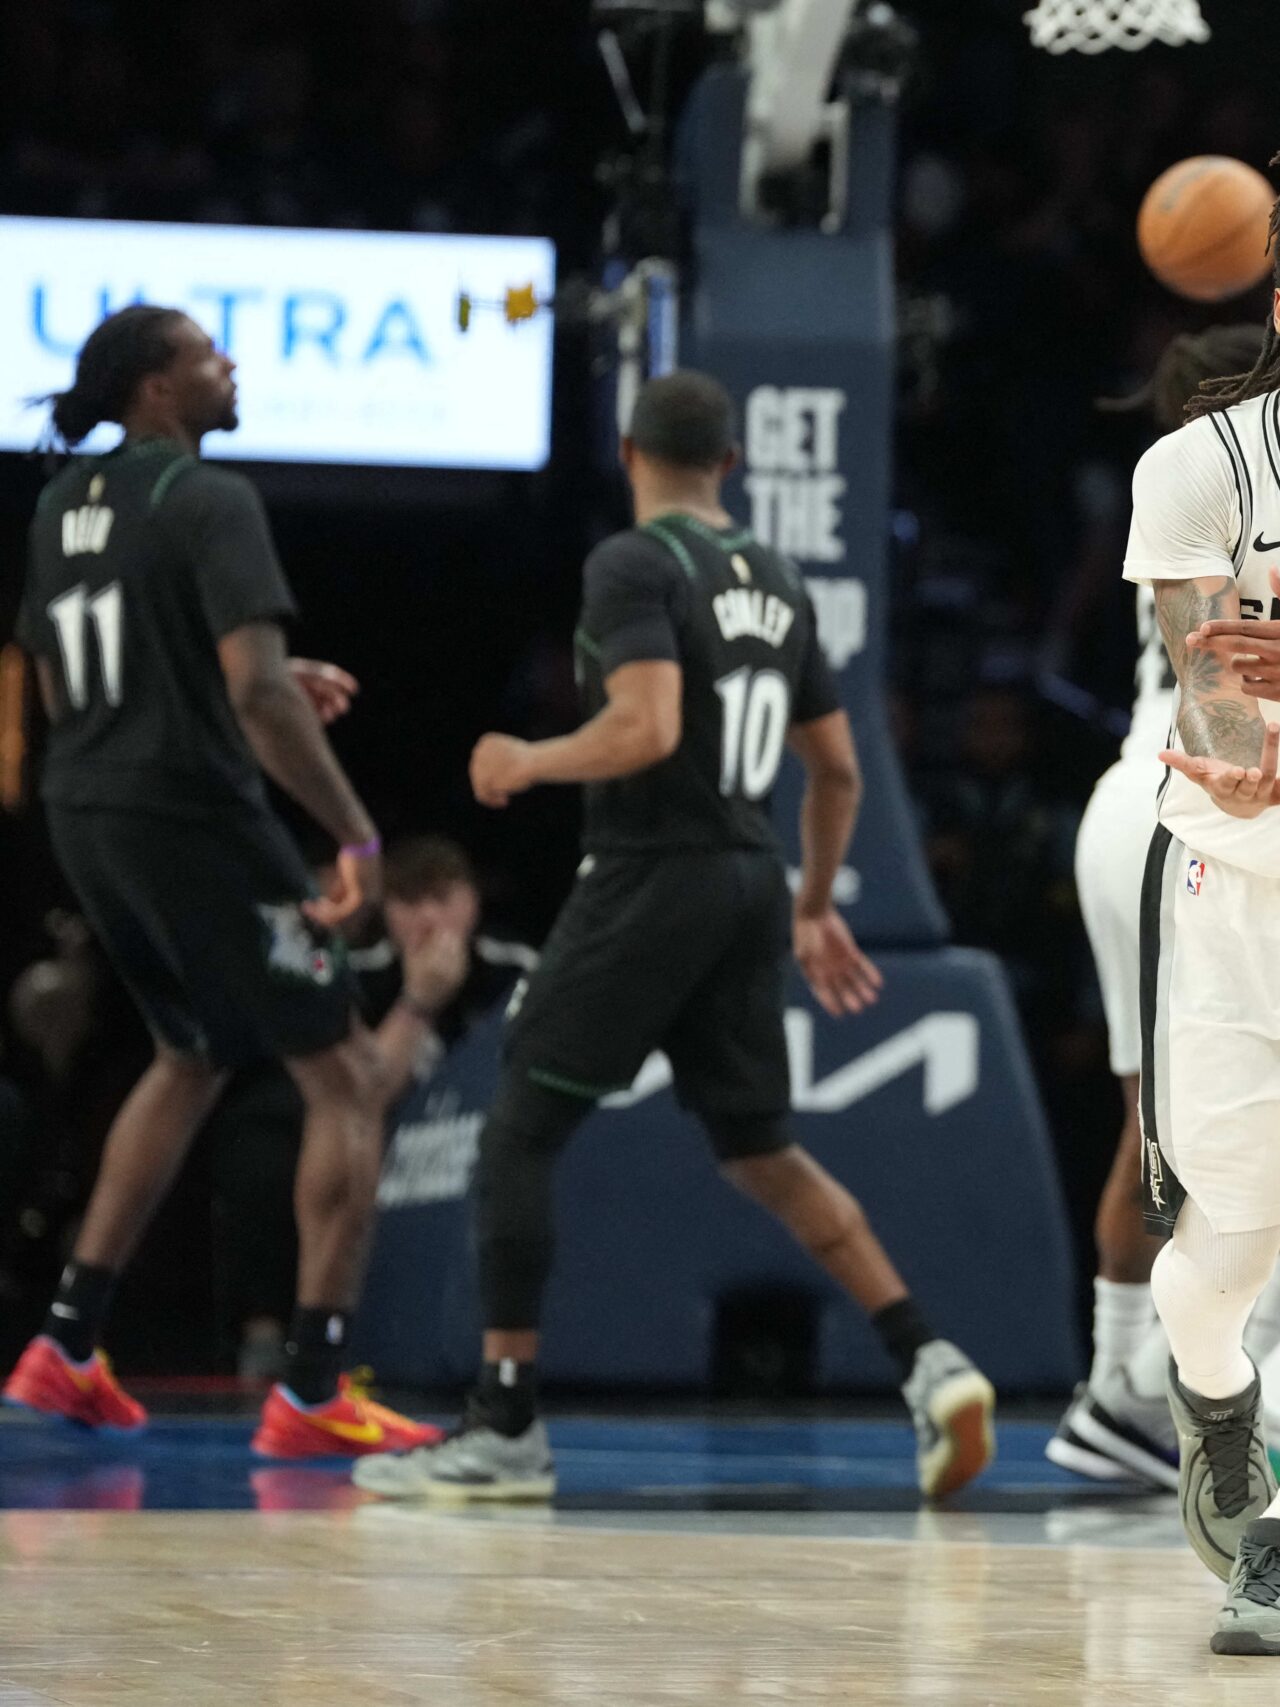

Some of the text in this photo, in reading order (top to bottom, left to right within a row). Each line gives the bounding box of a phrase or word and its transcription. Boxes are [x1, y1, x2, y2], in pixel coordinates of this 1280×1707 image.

[32, 284, 433, 364] UTRA
[745, 385, 846, 471] GET
[744, 473, 846, 563] THE
[47, 581, 122, 710] 11
[713, 664, 791, 800] 10
